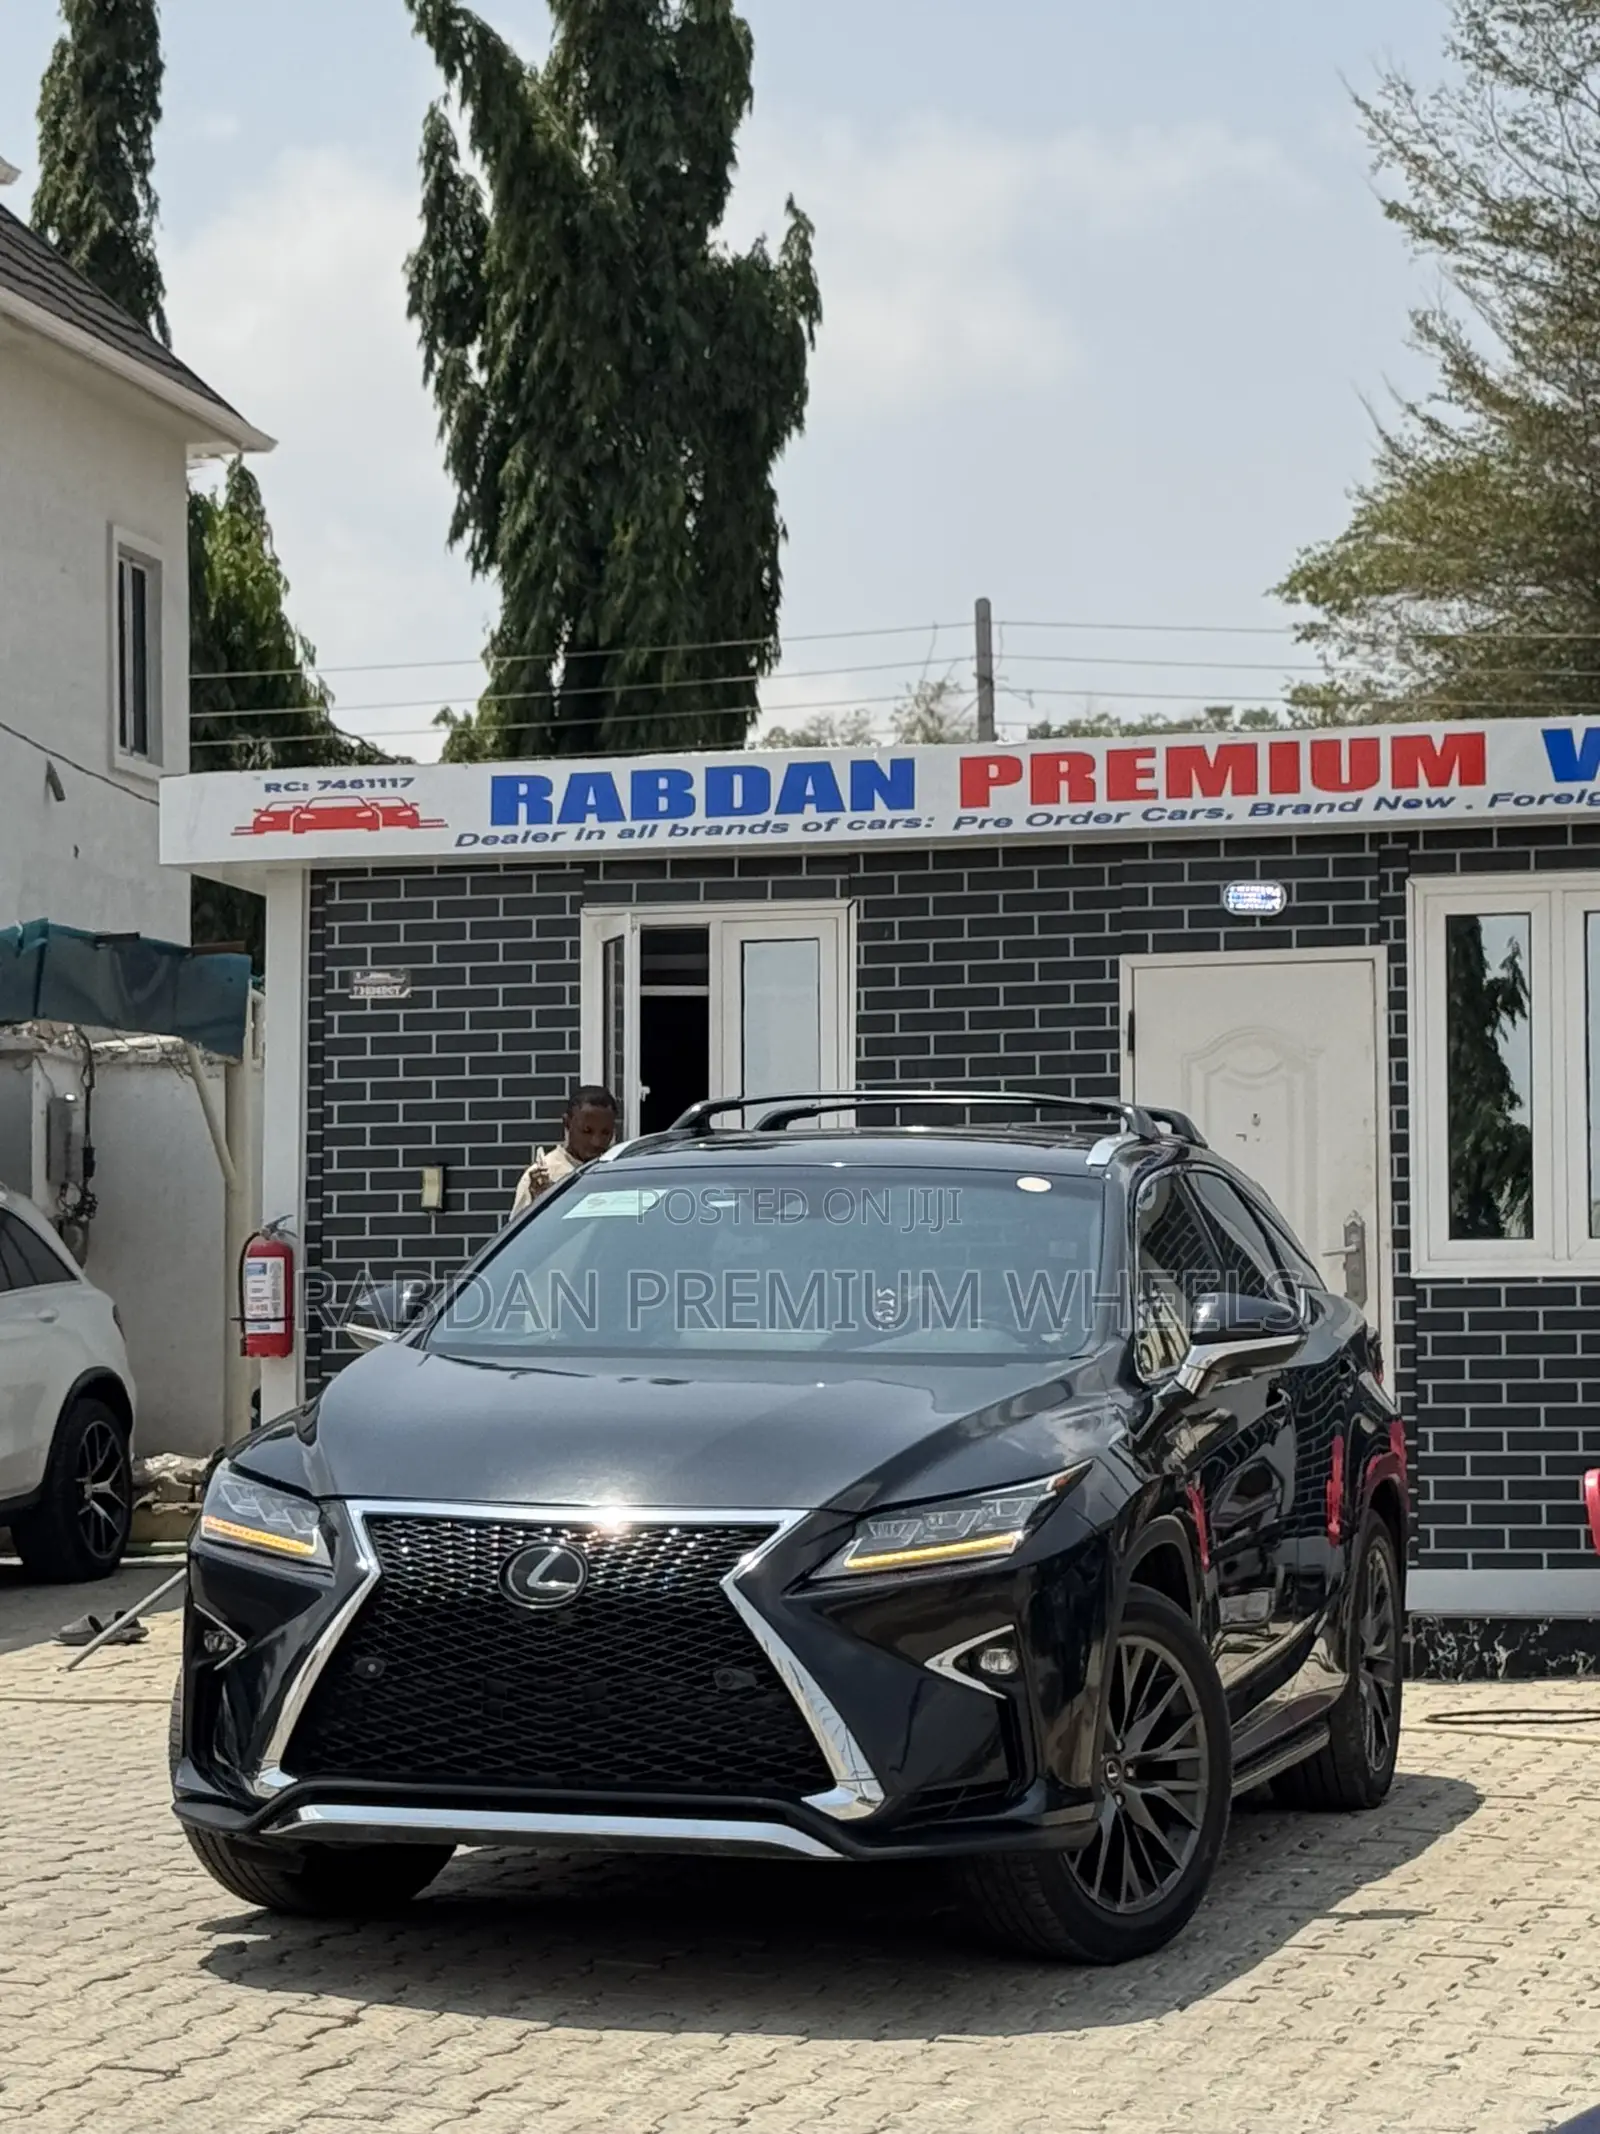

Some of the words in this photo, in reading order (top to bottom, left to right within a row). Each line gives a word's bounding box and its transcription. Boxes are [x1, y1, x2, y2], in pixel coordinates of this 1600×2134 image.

[264, 781, 309, 793] RC:
[490, 757, 916, 827] RABDAN
[959, 731, 1487, 809] PREMIUM
[454, 829, 566, 847] Dealer
[575, 828, 604, 841] in
[617, 824, 659, 839] all
[668, 820, 789, 837] brands
[801, 817, 841, 832] of
[847, 817, 935, 831] cars:
[953, 815, 1013, 830] Pre
[1025, 810, 1131, 827] Order
[1141, 807, 1234, 822] Cars,
[1248, 798, 1362, 818] Brand
[1373, 796, 1456, 812] New
